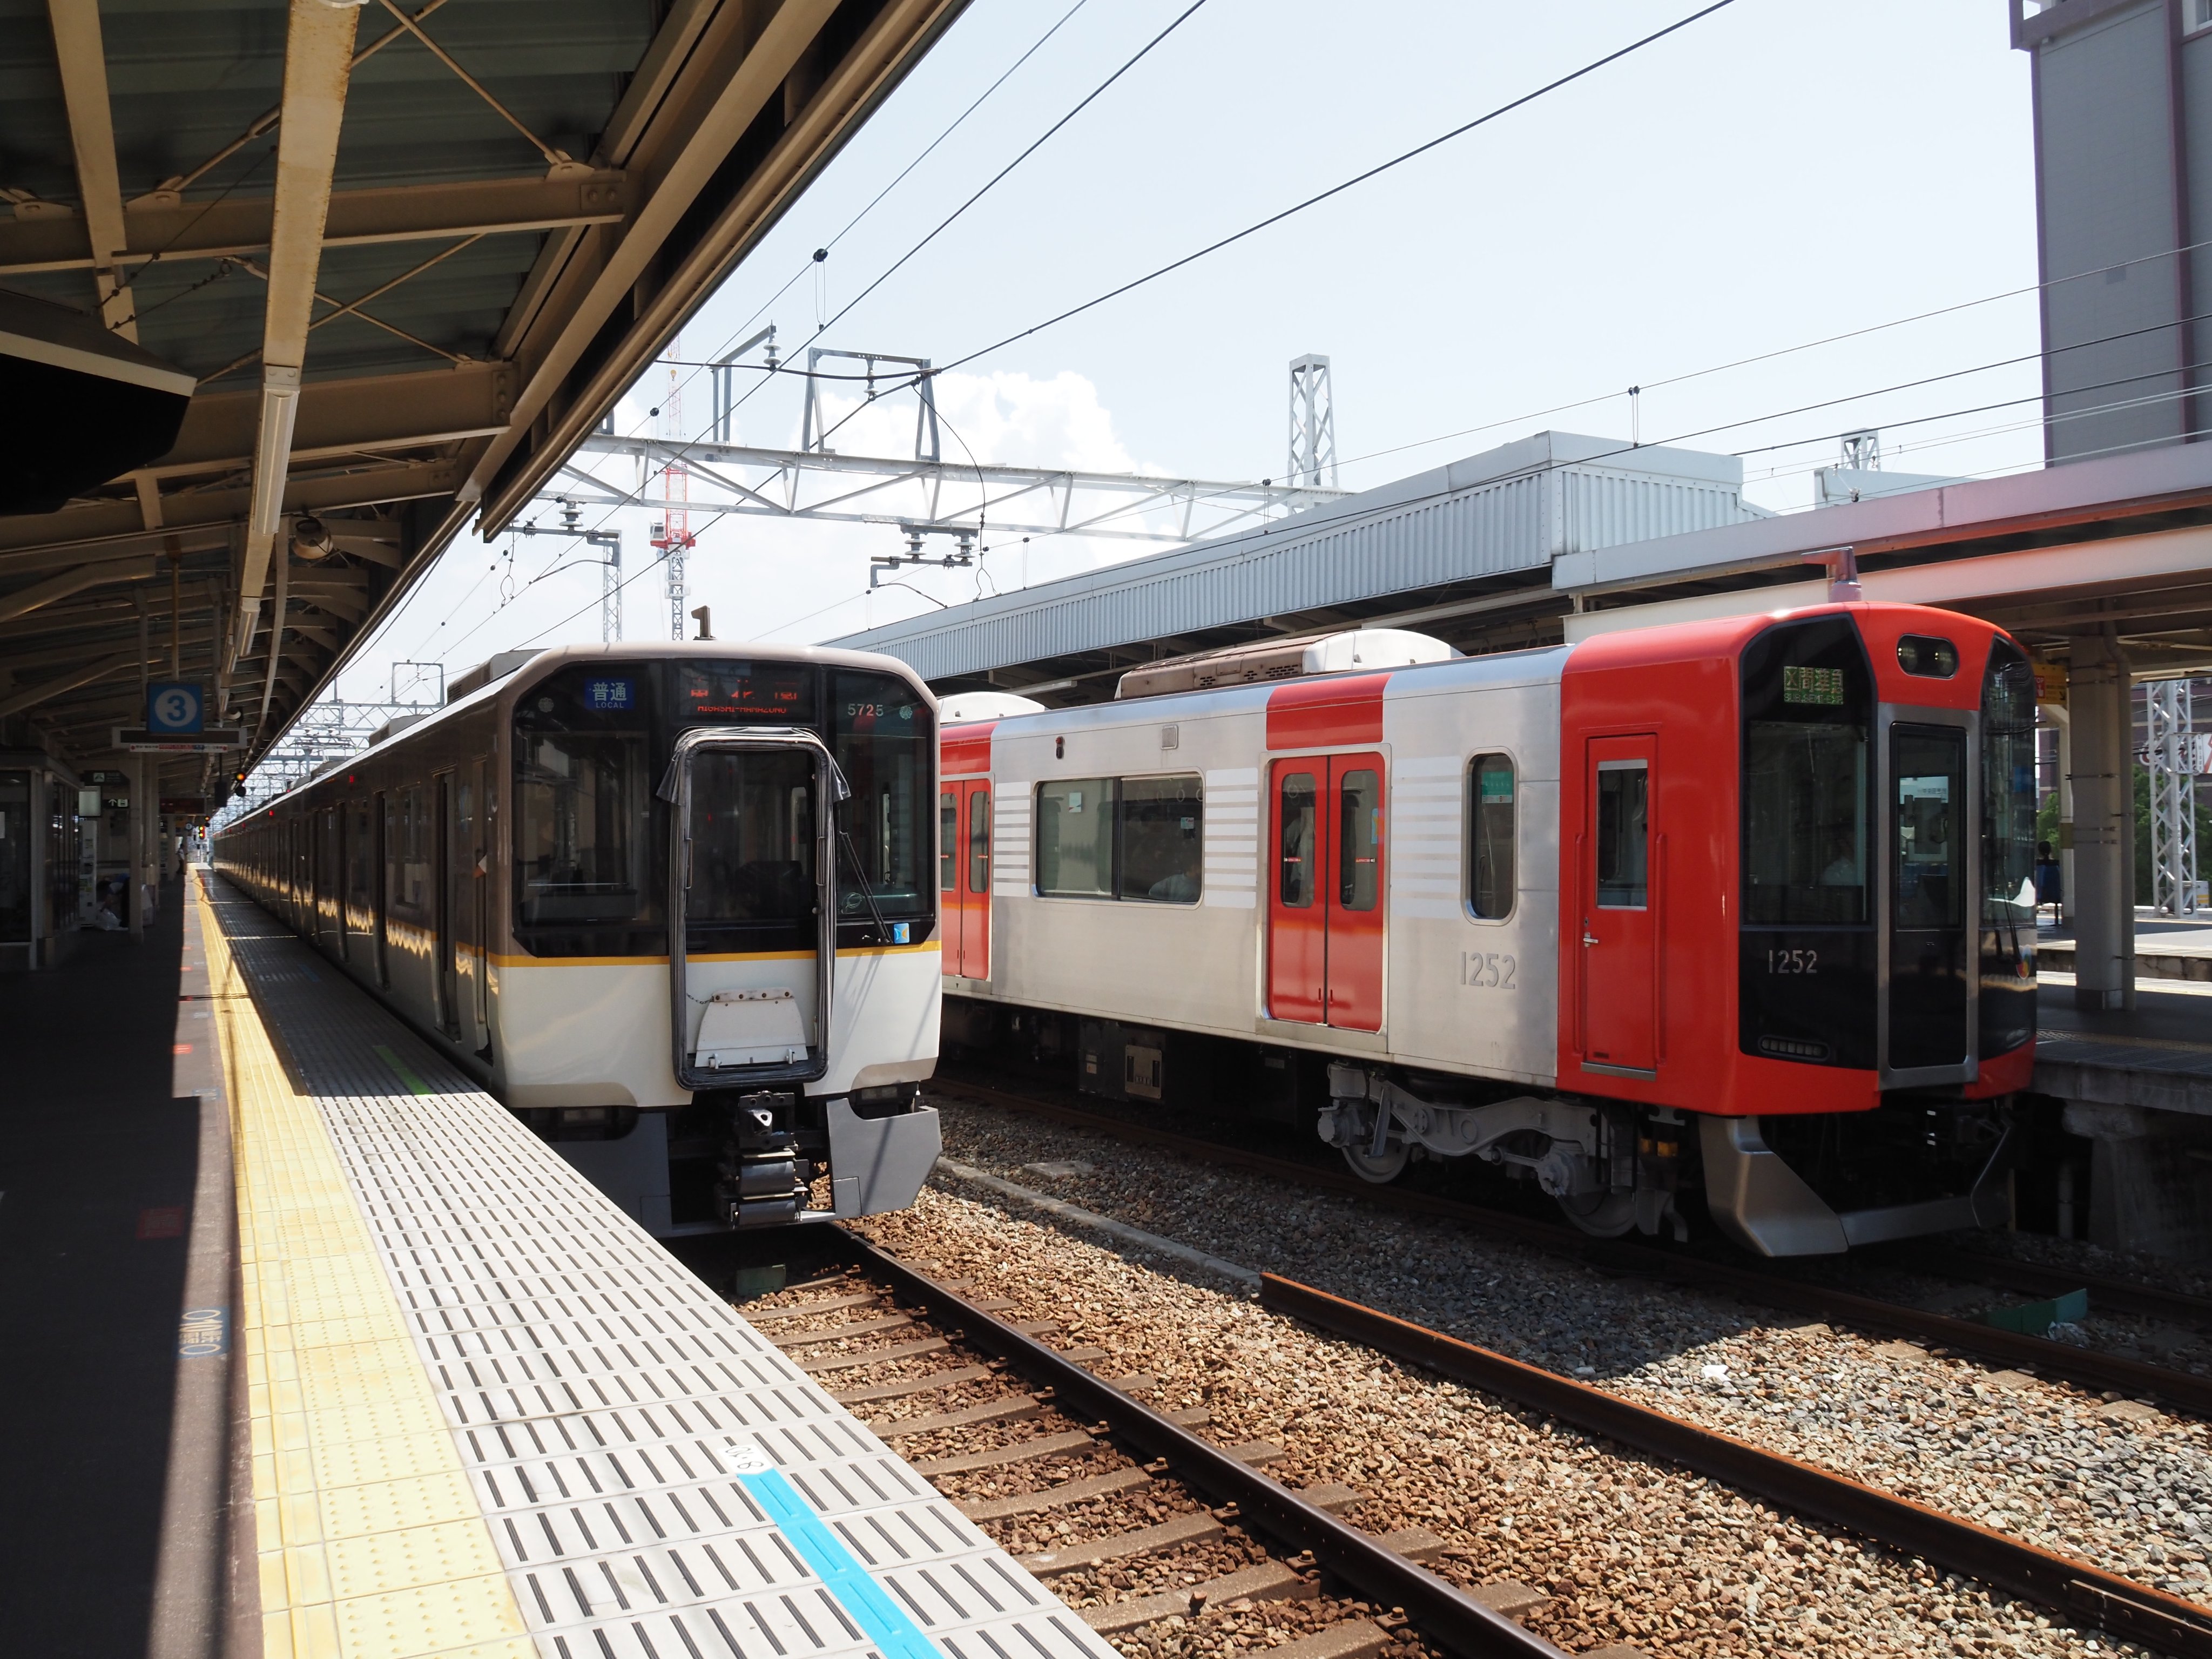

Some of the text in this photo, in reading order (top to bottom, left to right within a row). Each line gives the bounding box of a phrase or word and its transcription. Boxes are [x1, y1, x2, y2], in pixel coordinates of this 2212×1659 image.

[592, 682, 628, 702] 普通
[1784, 666, 1843, 693] 区間準急
[166, 694, 187, 721] 3
[847, 703, 884, 717] 5725
[1460, 951, 1515, 989] 1252
[1769, 950, 1817, 973] 1252
